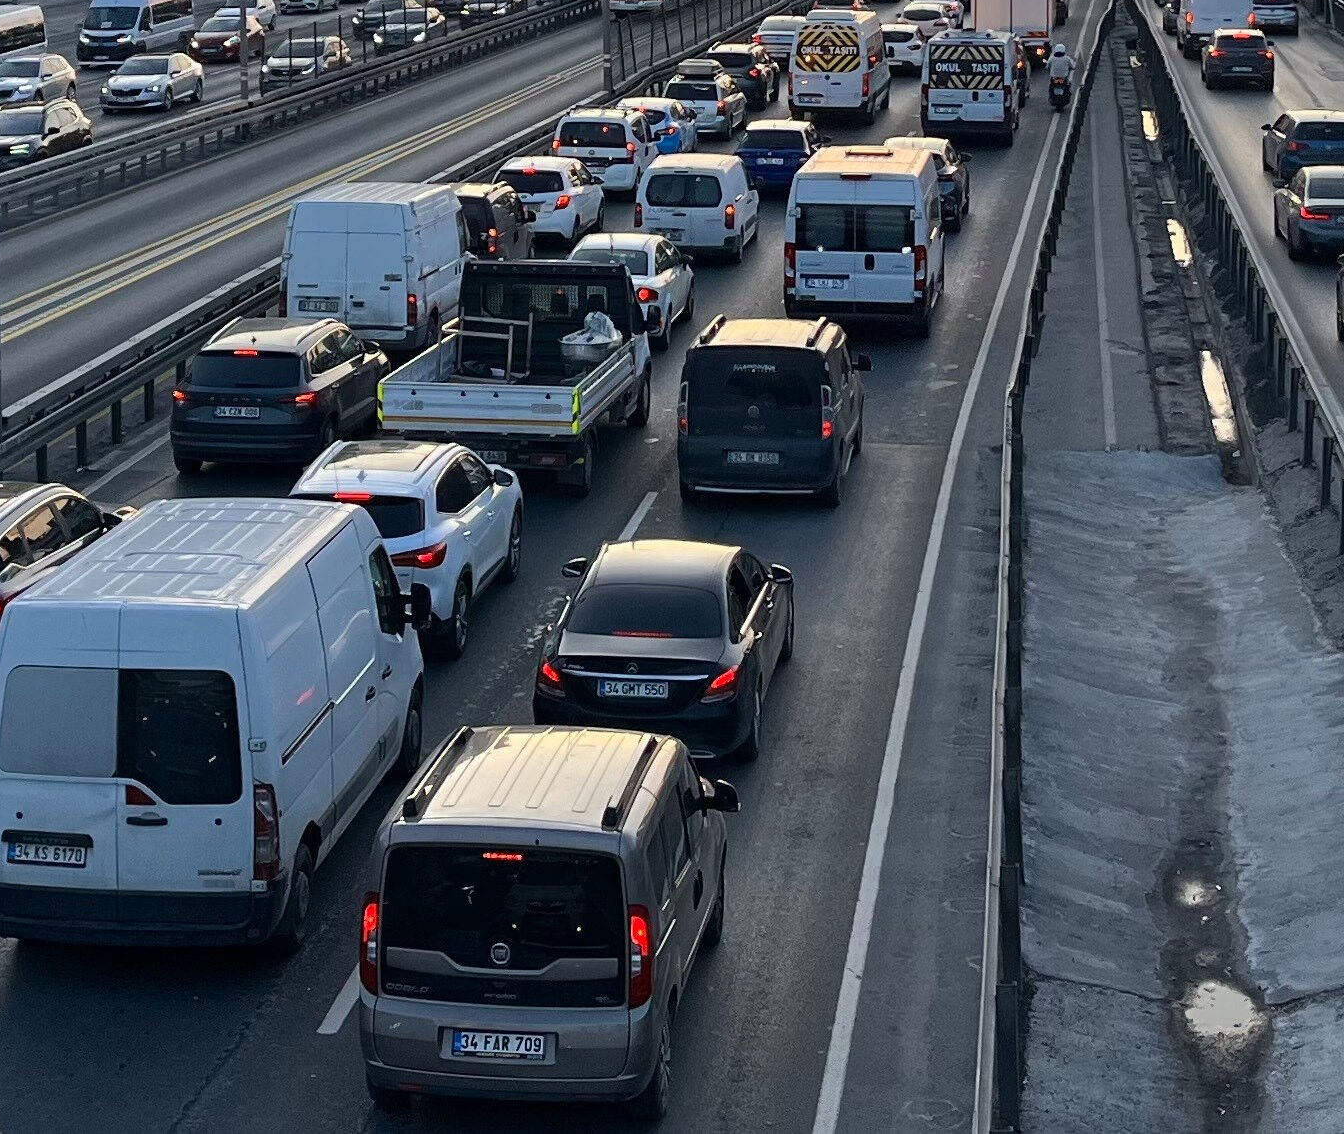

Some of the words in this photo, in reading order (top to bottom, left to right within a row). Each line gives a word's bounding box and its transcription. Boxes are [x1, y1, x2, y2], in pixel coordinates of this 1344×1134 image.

[800, 46, 823, 56] OKUL
[829, 45, 857, 56] TAŞITI
[935, 62, 962, 73] OKUL
[971, 62, 1000, 75] TAŞITI
[605, 682, 619, 695] 34
[622, 683, 642, 696] GMT
[645, 683, 665, 697] 550
[16, 845, 29, 859] 34
[35, 846, 47, 861] KS
[53, 847, 82, 863] 6170
[462, 1034, 478, 1050] 34
[484, 1035, 509, 1051] FAR
[515, 1036, 542, 1053] 709
